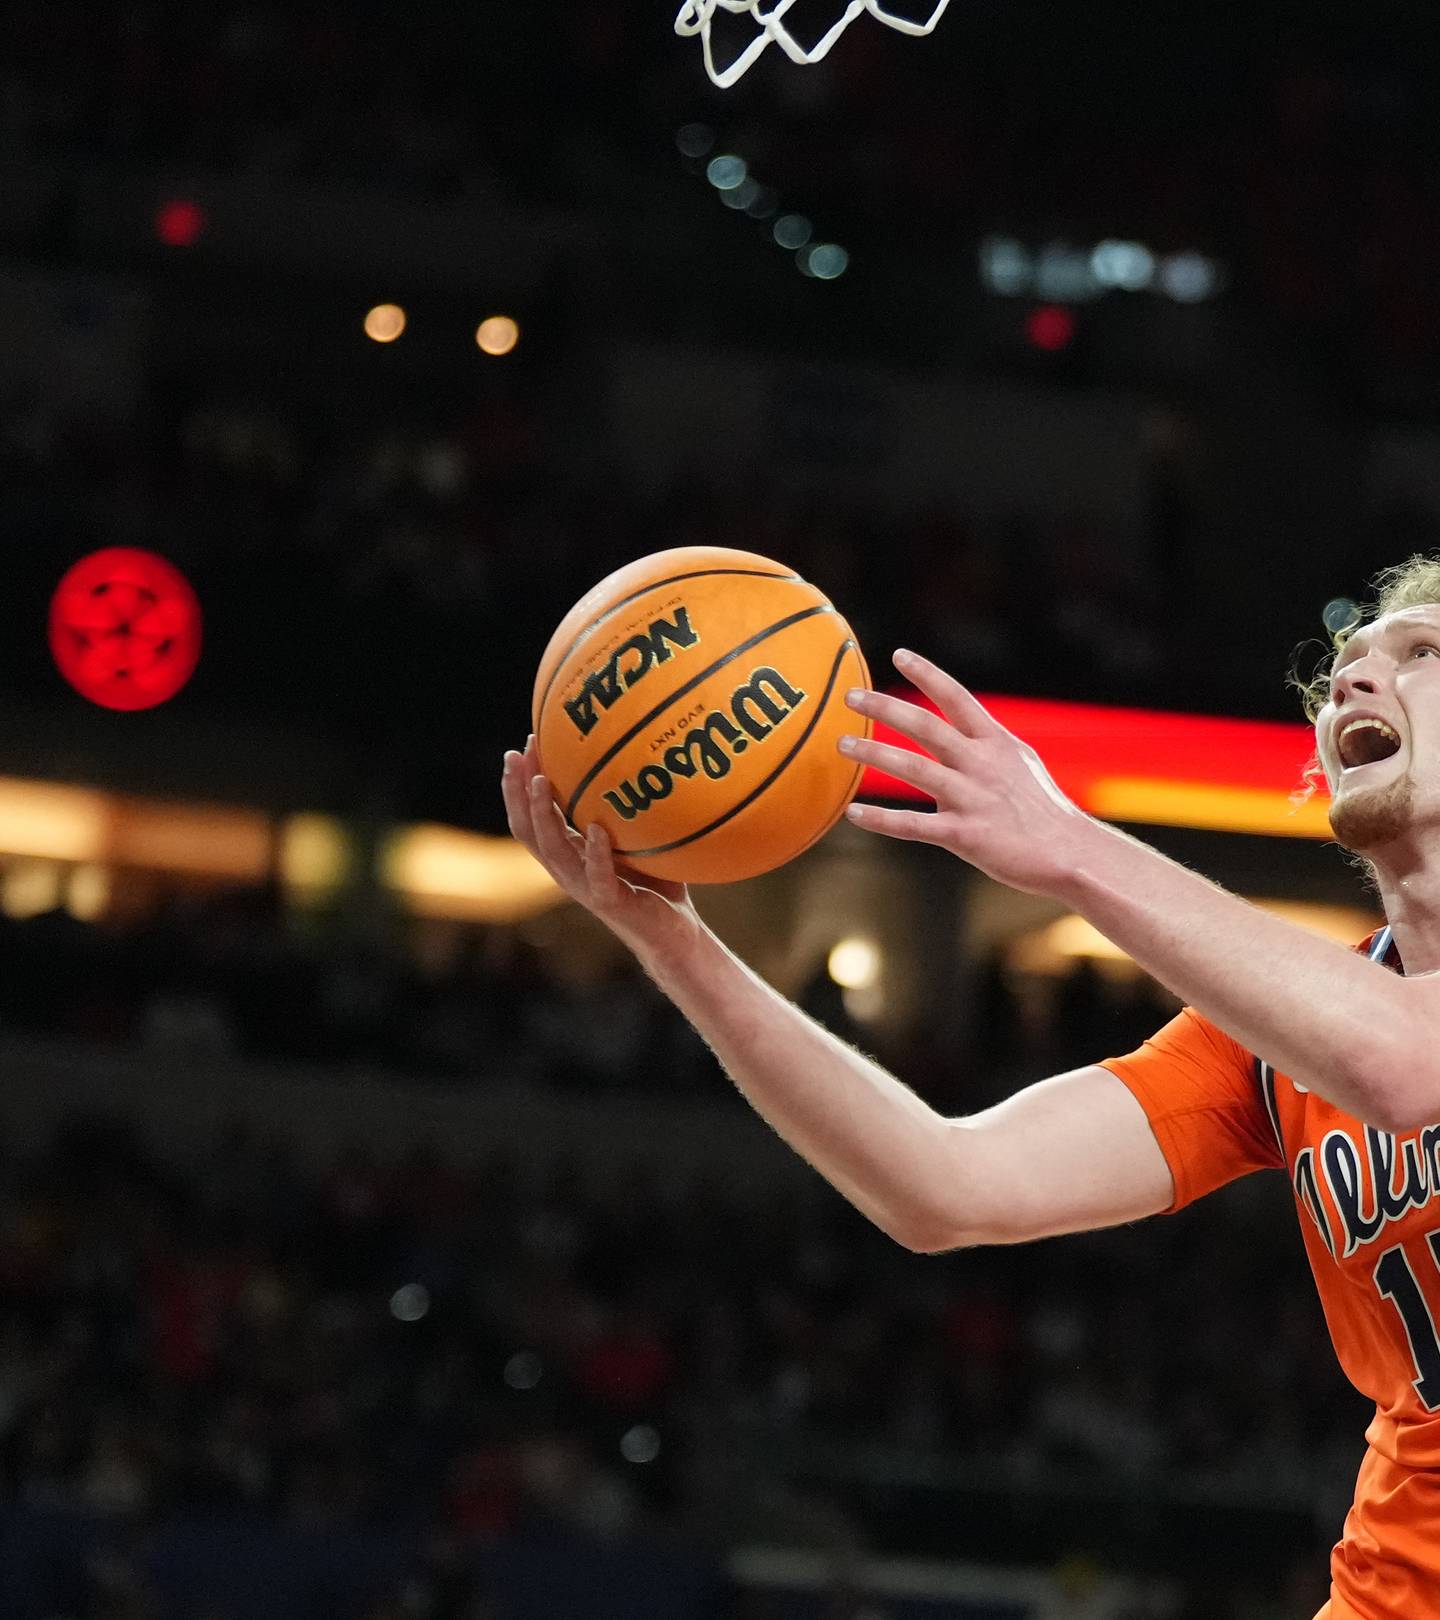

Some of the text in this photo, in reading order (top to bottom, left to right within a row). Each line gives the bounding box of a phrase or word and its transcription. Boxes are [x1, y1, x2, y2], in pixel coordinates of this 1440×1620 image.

[563, 606, 700, 736] NCAA
[650, 703, 706, 752] EVO NXT
[602, 666, 809, 821] Wilson
